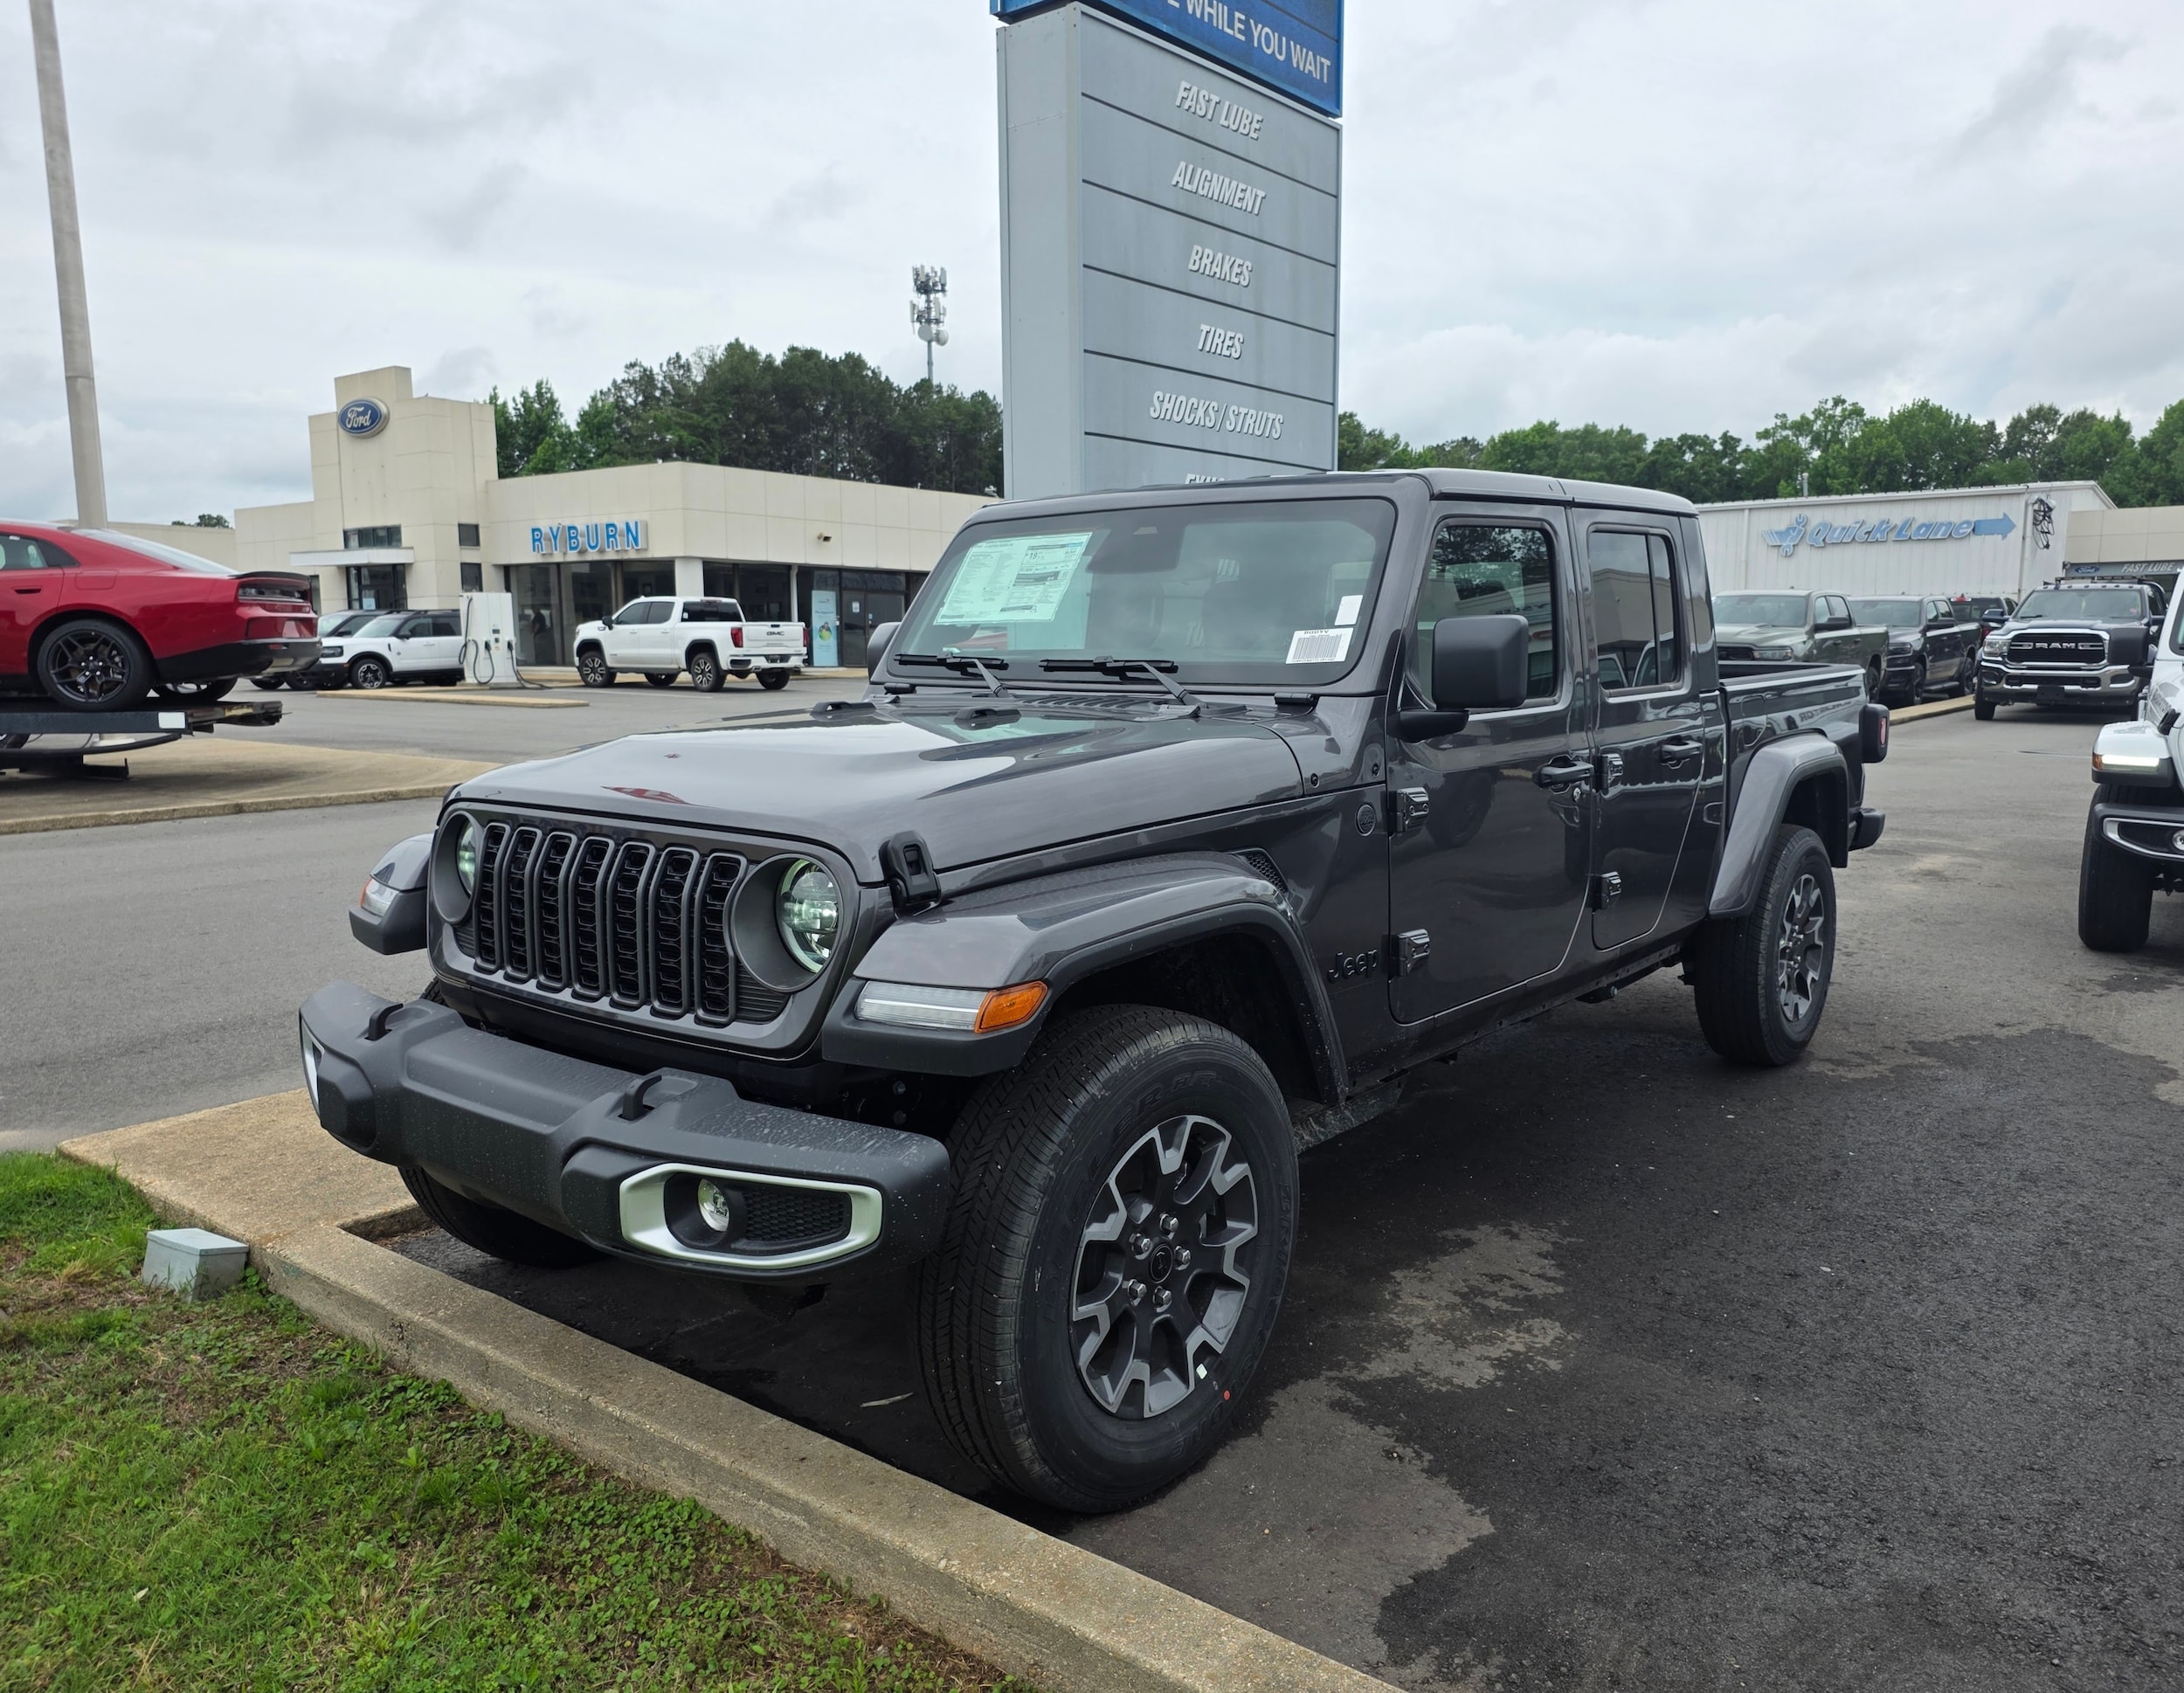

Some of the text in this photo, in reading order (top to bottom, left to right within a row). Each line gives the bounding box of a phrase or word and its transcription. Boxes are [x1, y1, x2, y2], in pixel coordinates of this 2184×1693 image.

[1187, 0, 1331, 84] WHILE YOU WAIT
[1175, 80, 1263, 141] FAST LUBE
[1171, 161, 1266, 216] ALIGNMENT
[1188, 245, 1253, 287] BRAKES
[1198, 323, 1245, 359] TIRES
[346, 407, 371, 428] Ford
[531, 520, 641, 555] RYBURN
[2120, 562, 2175, 573] FAST LUBE
[1327, 949, 1379, 985] Jeep
